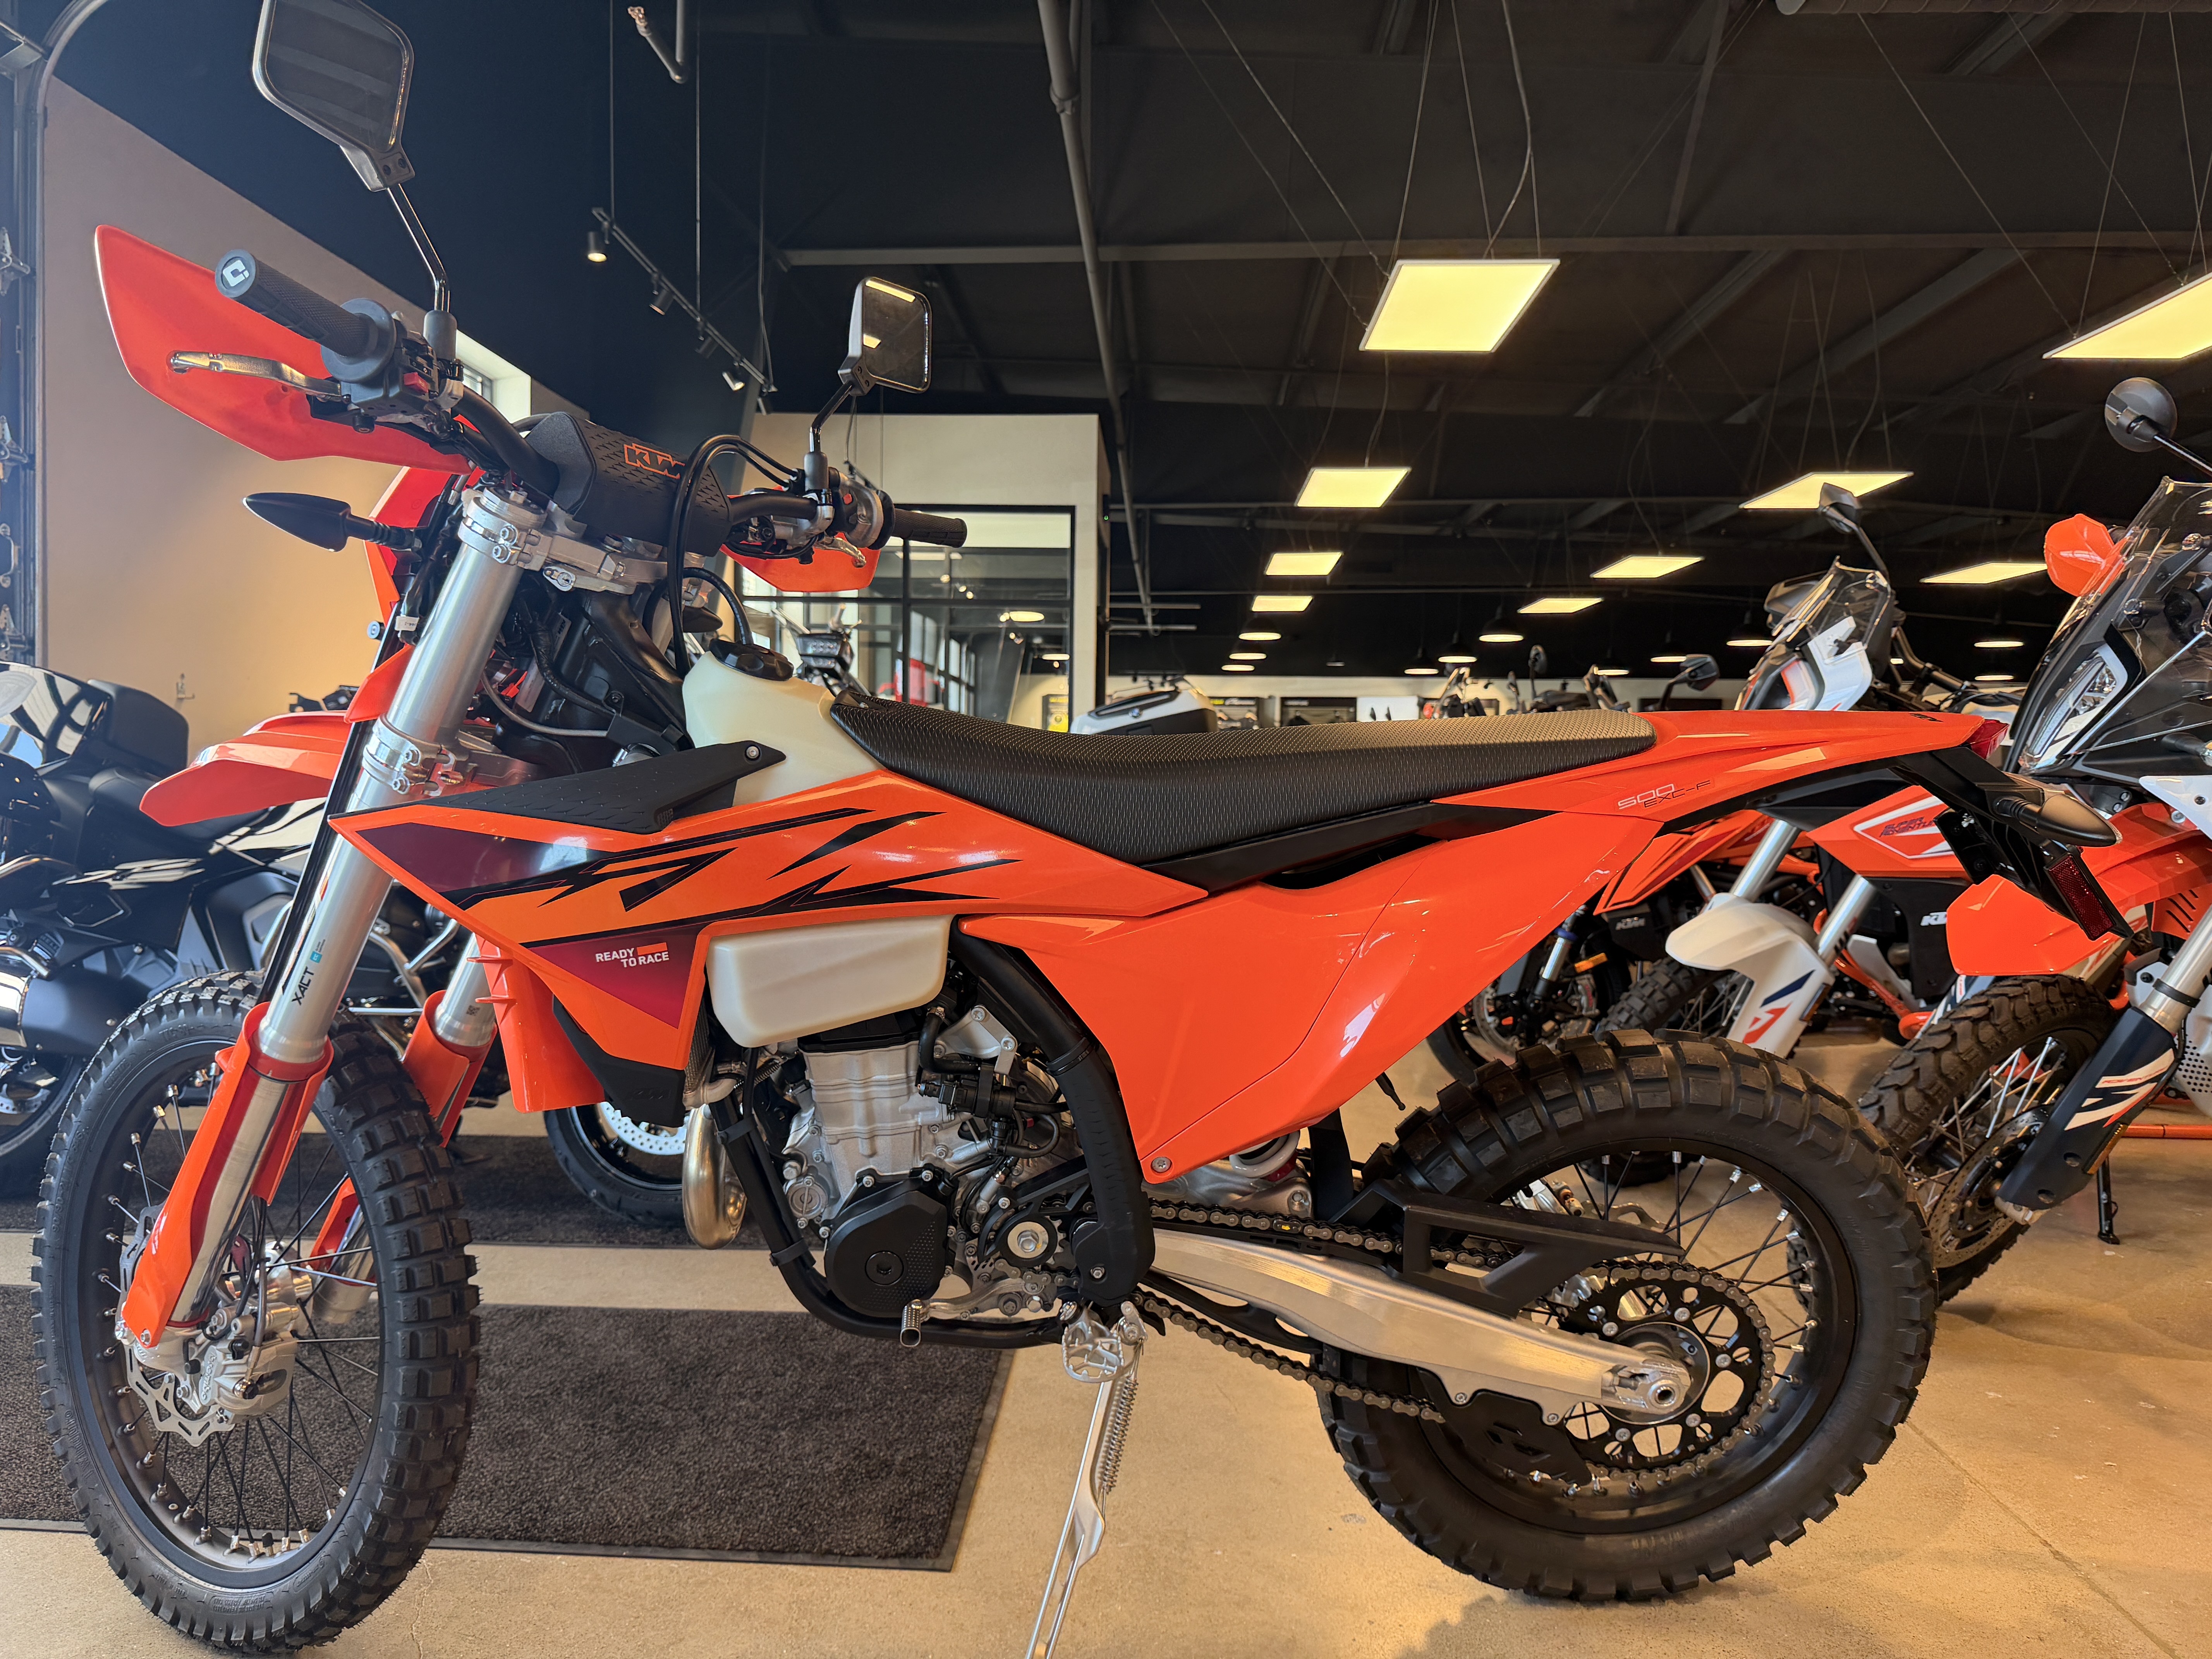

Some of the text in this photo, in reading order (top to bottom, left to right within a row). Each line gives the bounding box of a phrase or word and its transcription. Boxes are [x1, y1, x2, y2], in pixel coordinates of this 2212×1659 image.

[623, 443, 685, 479] KTM
[1618, 783, 1675, 810] 500
[1644, 780, 1711, 808] EXC-F
[1920, 911, 1947, 926] KT
[595, 947, 635, 962] READY
[620, 951, 670, 968] TO RACE
[292, 966, 314, 1006] XACT
